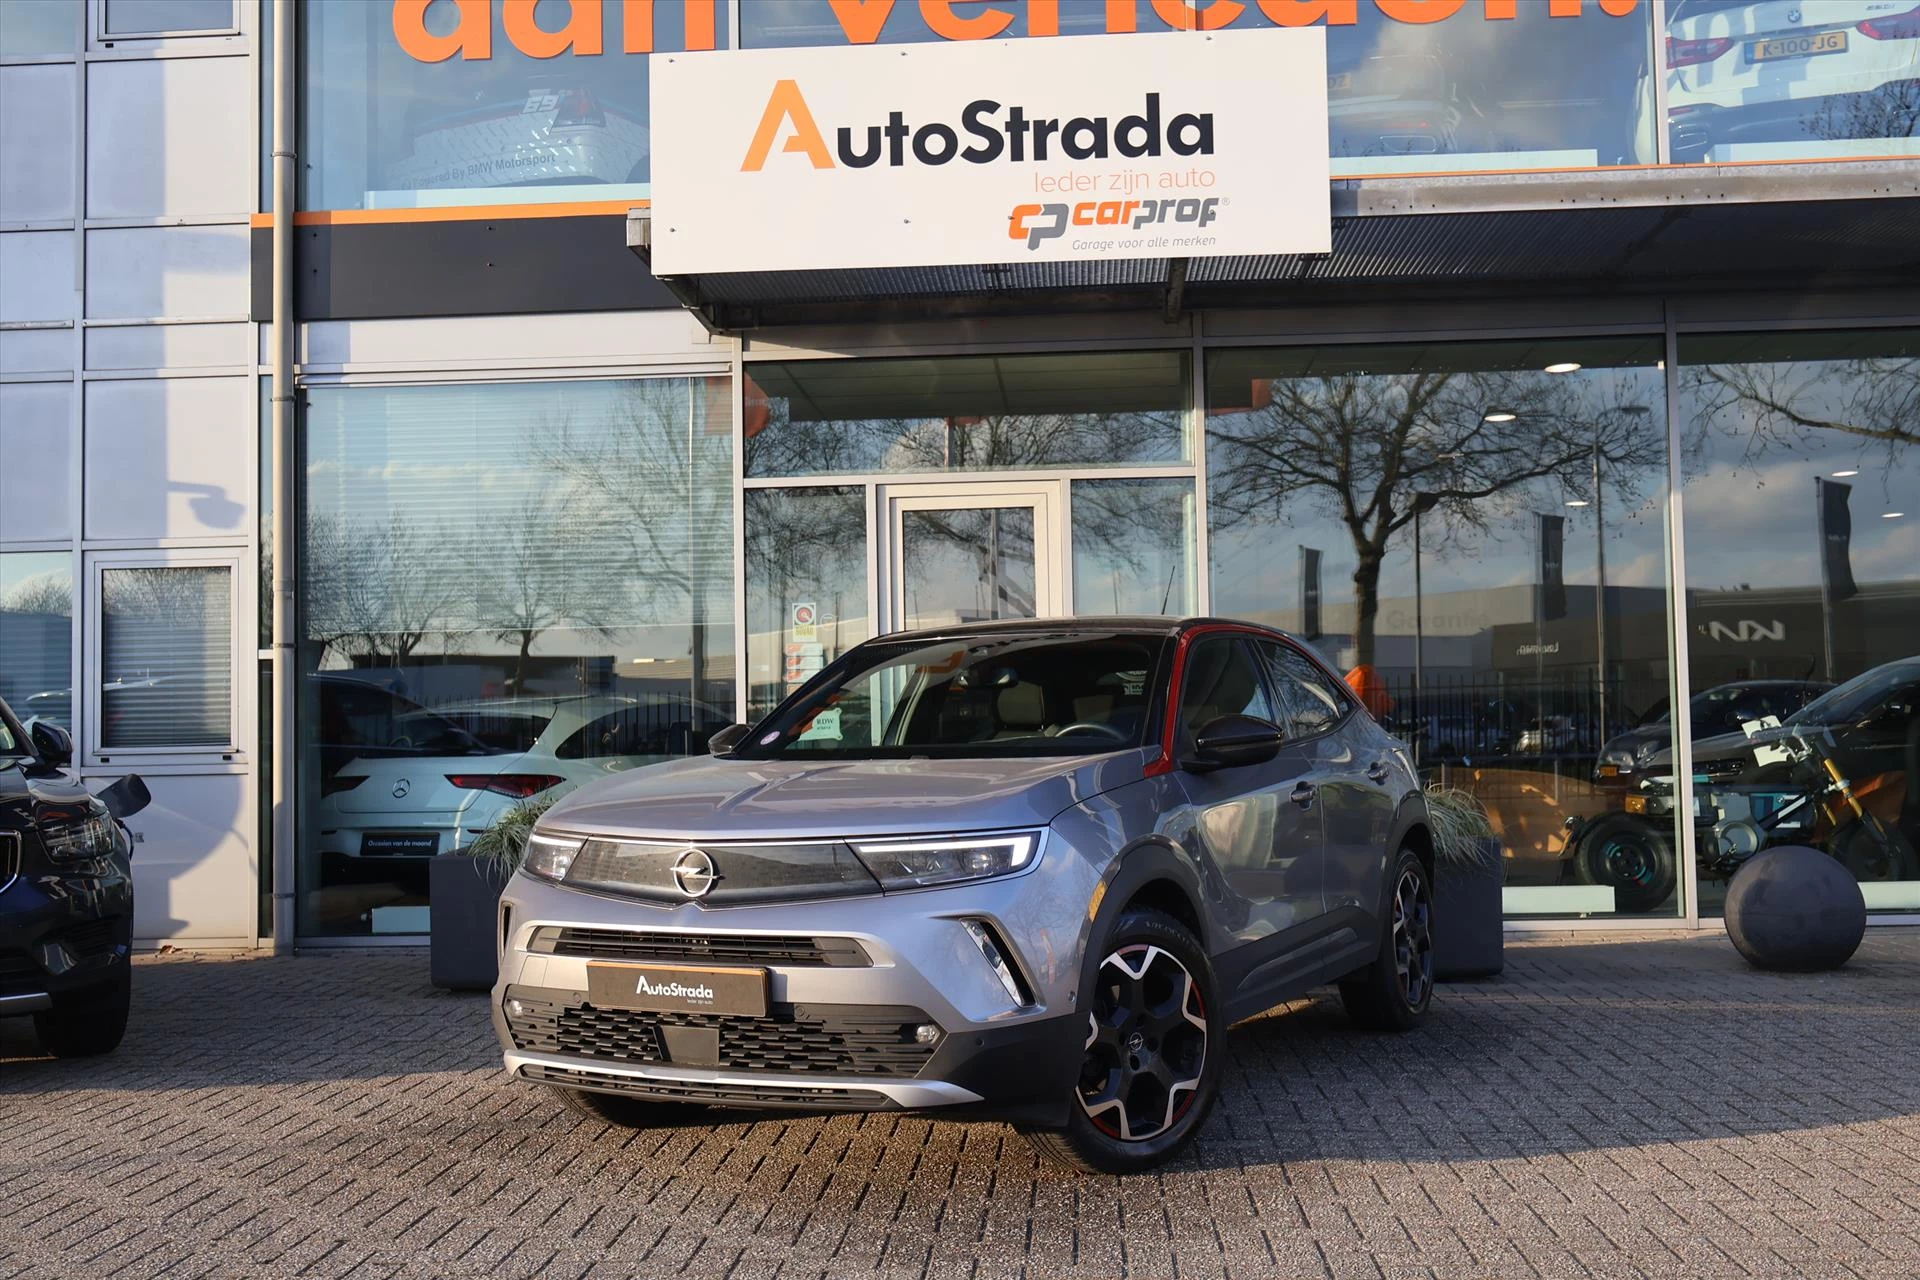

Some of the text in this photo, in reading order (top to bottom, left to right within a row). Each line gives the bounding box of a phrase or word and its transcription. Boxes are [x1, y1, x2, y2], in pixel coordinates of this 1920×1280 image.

[1763, 36, 1838, 57] K-100-JG
[740, 79, 1215, 172] AutoStrada
[452, 166, 466, 181] By
[467, 161, 494, 177] BMW
[495, 153, 556, 172] Motorsport
[1034, 167, 1217, 195] Ieder zijn auto
[1072, 235, 1216, 252] Garage voor alle merken
[636, 975, 713, 999] AutoStrada
